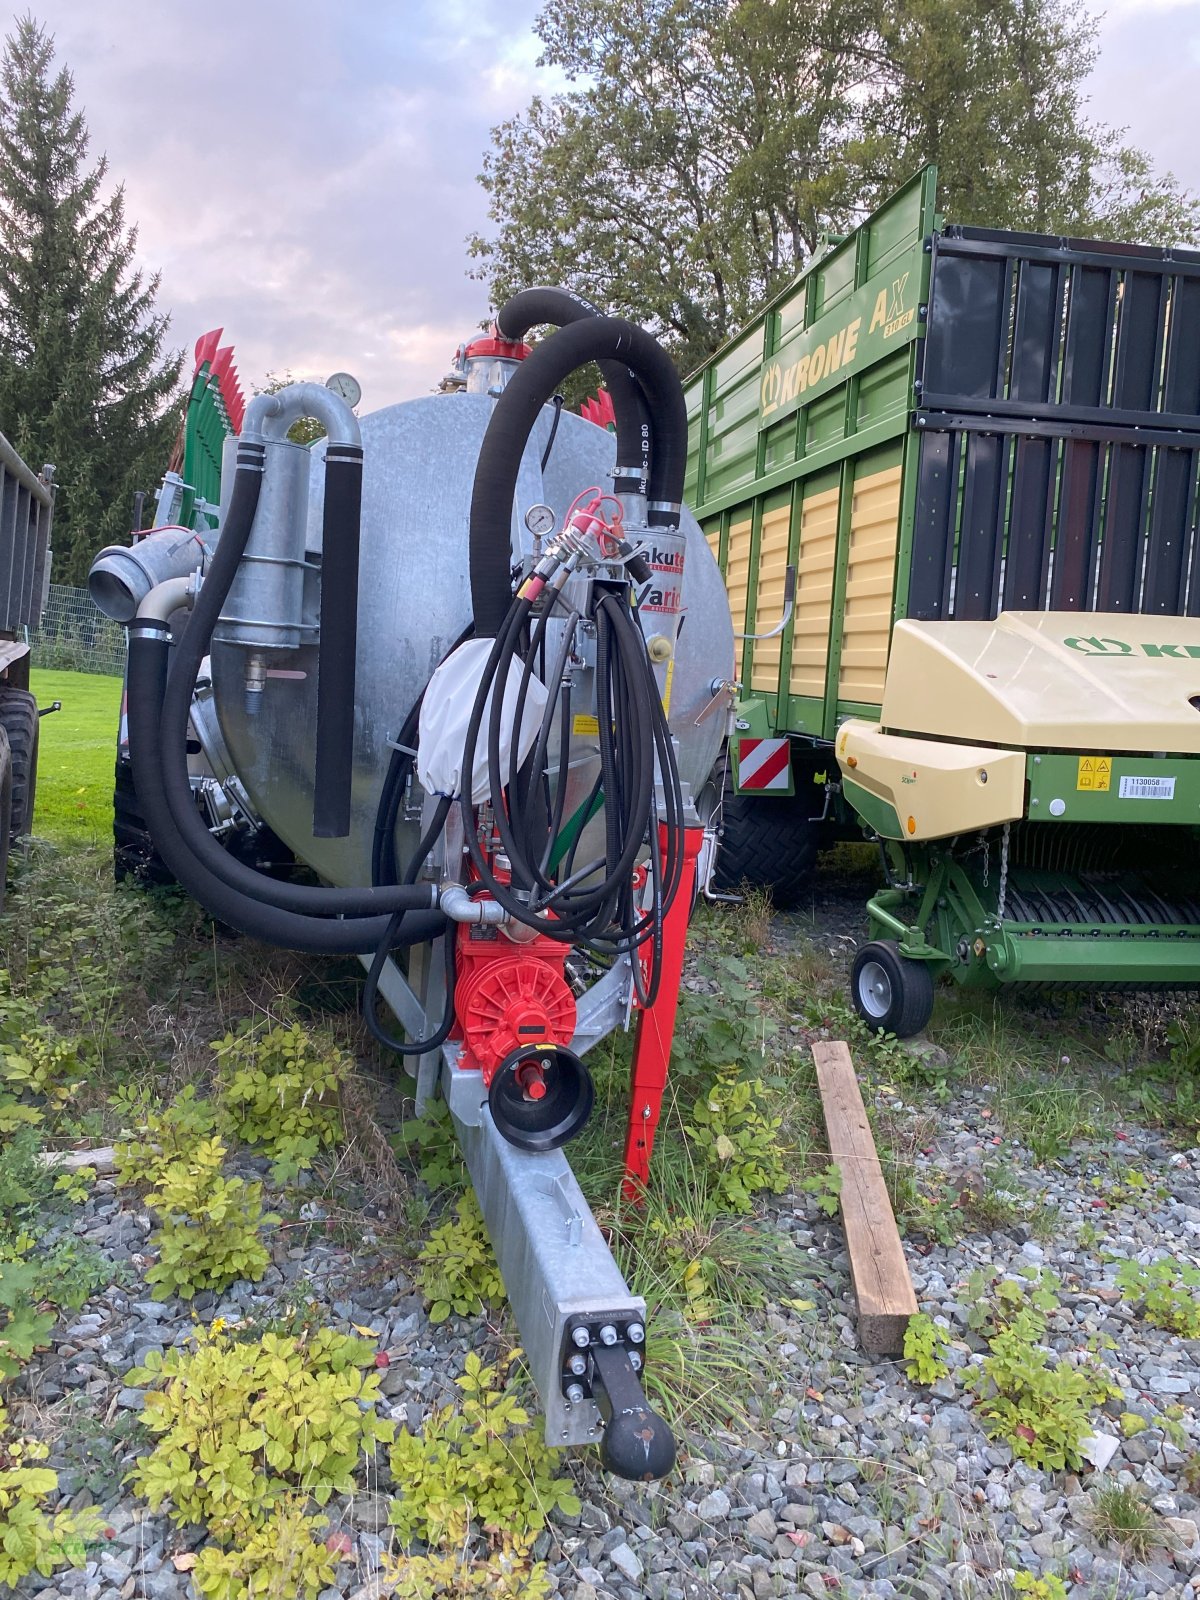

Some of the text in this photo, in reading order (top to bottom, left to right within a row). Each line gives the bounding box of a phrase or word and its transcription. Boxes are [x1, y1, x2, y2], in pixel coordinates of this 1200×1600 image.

[780, 272, 910, 406] KRONE AX
[641, 424, 649, 438] 80
[641, 440, 649, 452] ID
[1132, 778, 1161, 786] 1130058
